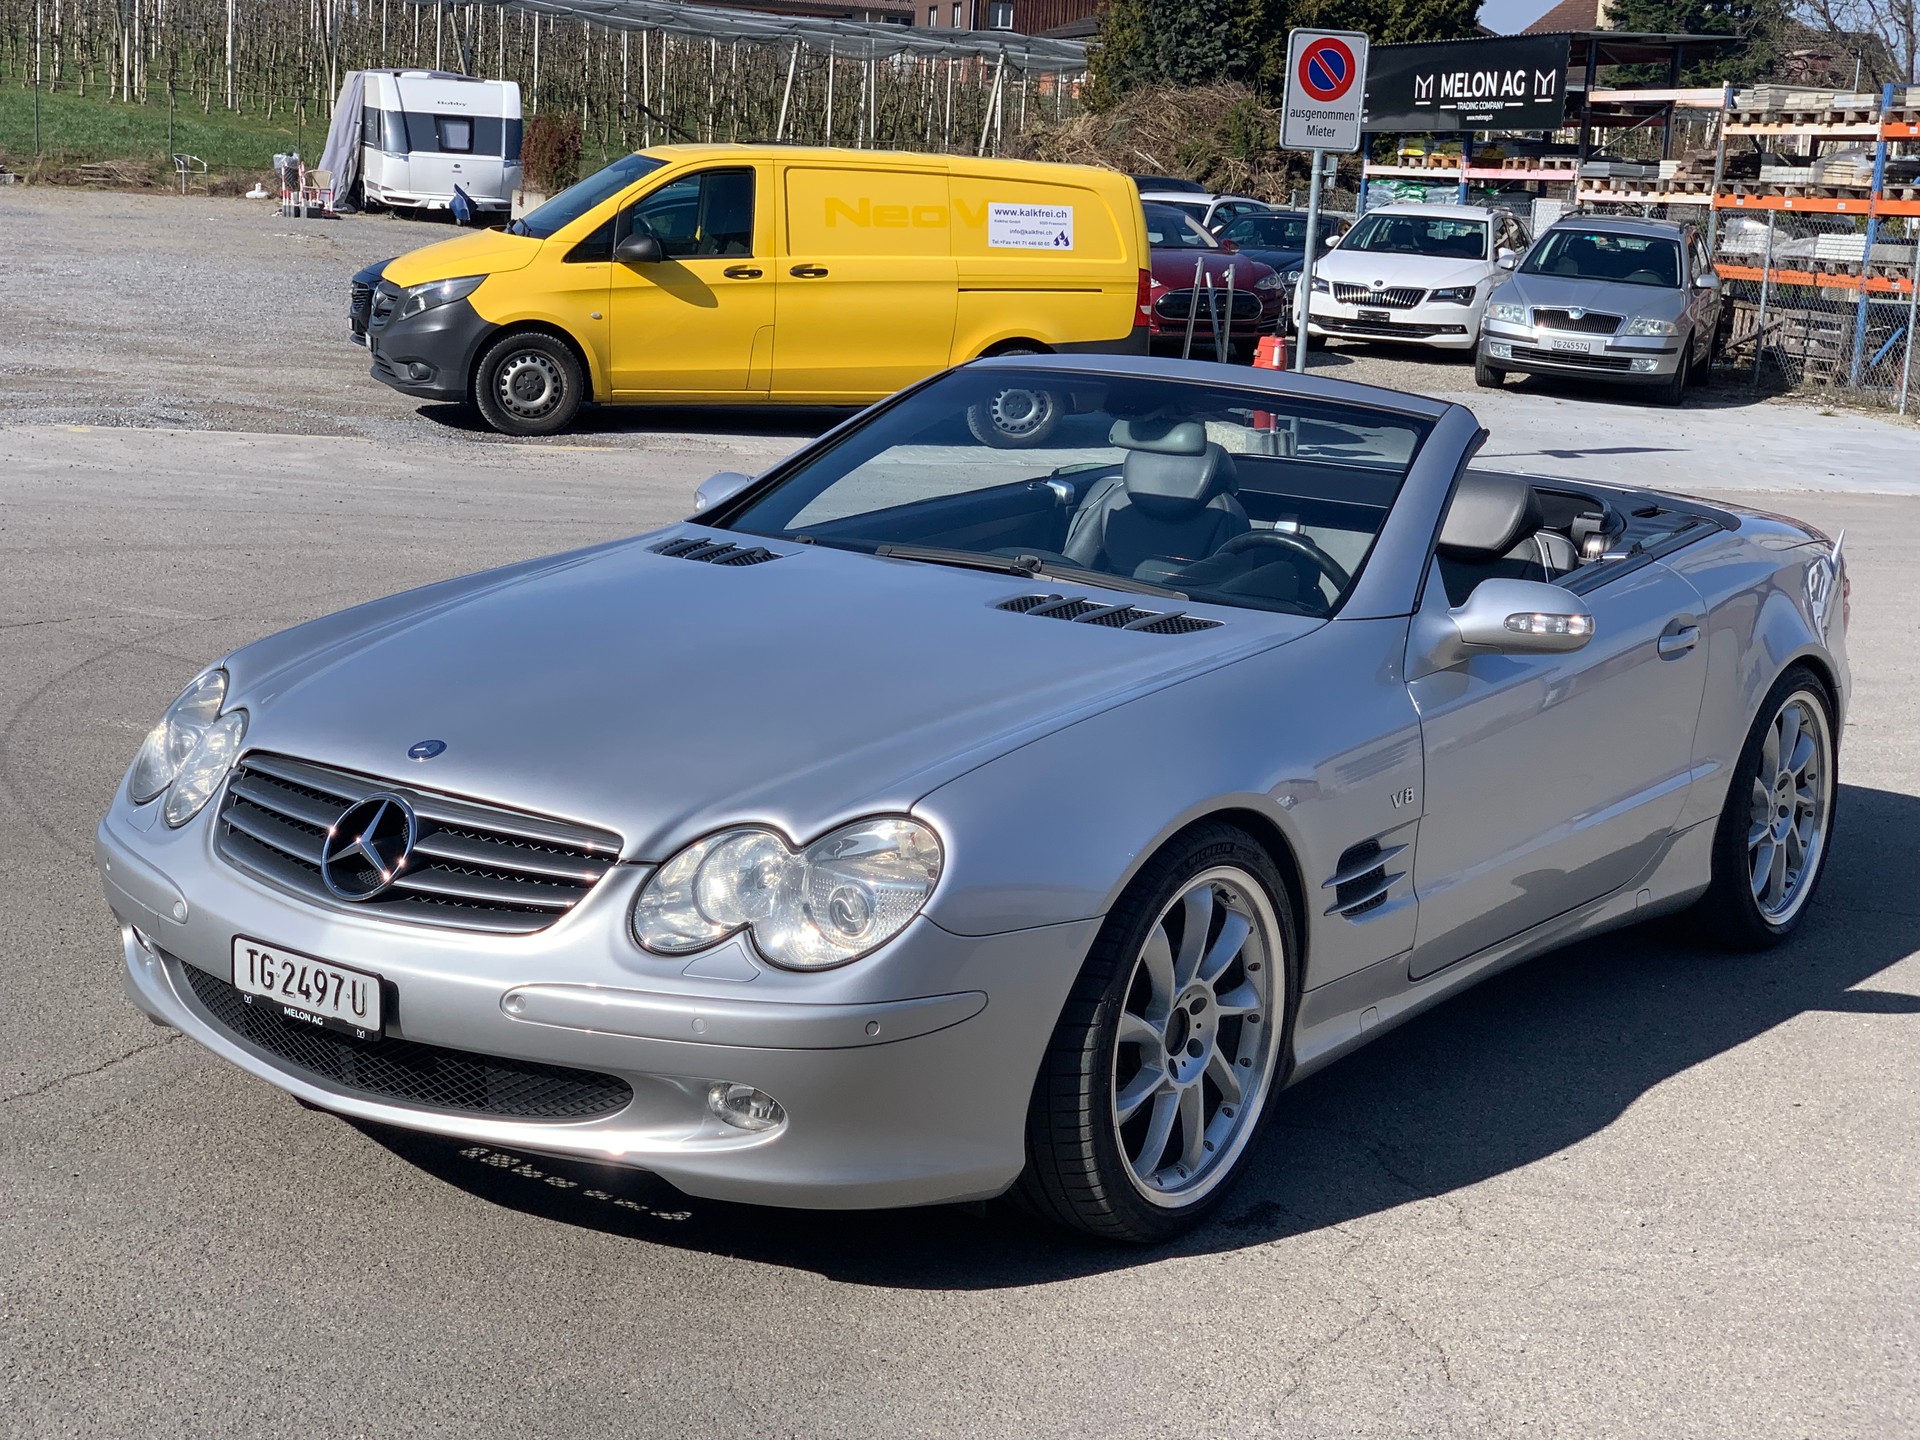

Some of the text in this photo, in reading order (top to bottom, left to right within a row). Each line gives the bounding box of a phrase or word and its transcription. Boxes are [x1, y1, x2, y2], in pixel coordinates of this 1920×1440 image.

[1440, 69, 1526, 98] MELON AG
[1456, 101, 1504, 110] TRADING COMPANY
[1289, 108, 1355, 121] ausgenommen
[1306, 125, 1336, 137] Mieter
[994, 208, 1067, 218] www.kalkfrei.ch
[1009, 228, 1053, 236] info@kalkfrei.ch
[1390, 786, 1414, 809] V8
[283, 1006, 324, 1027] MELON AG
